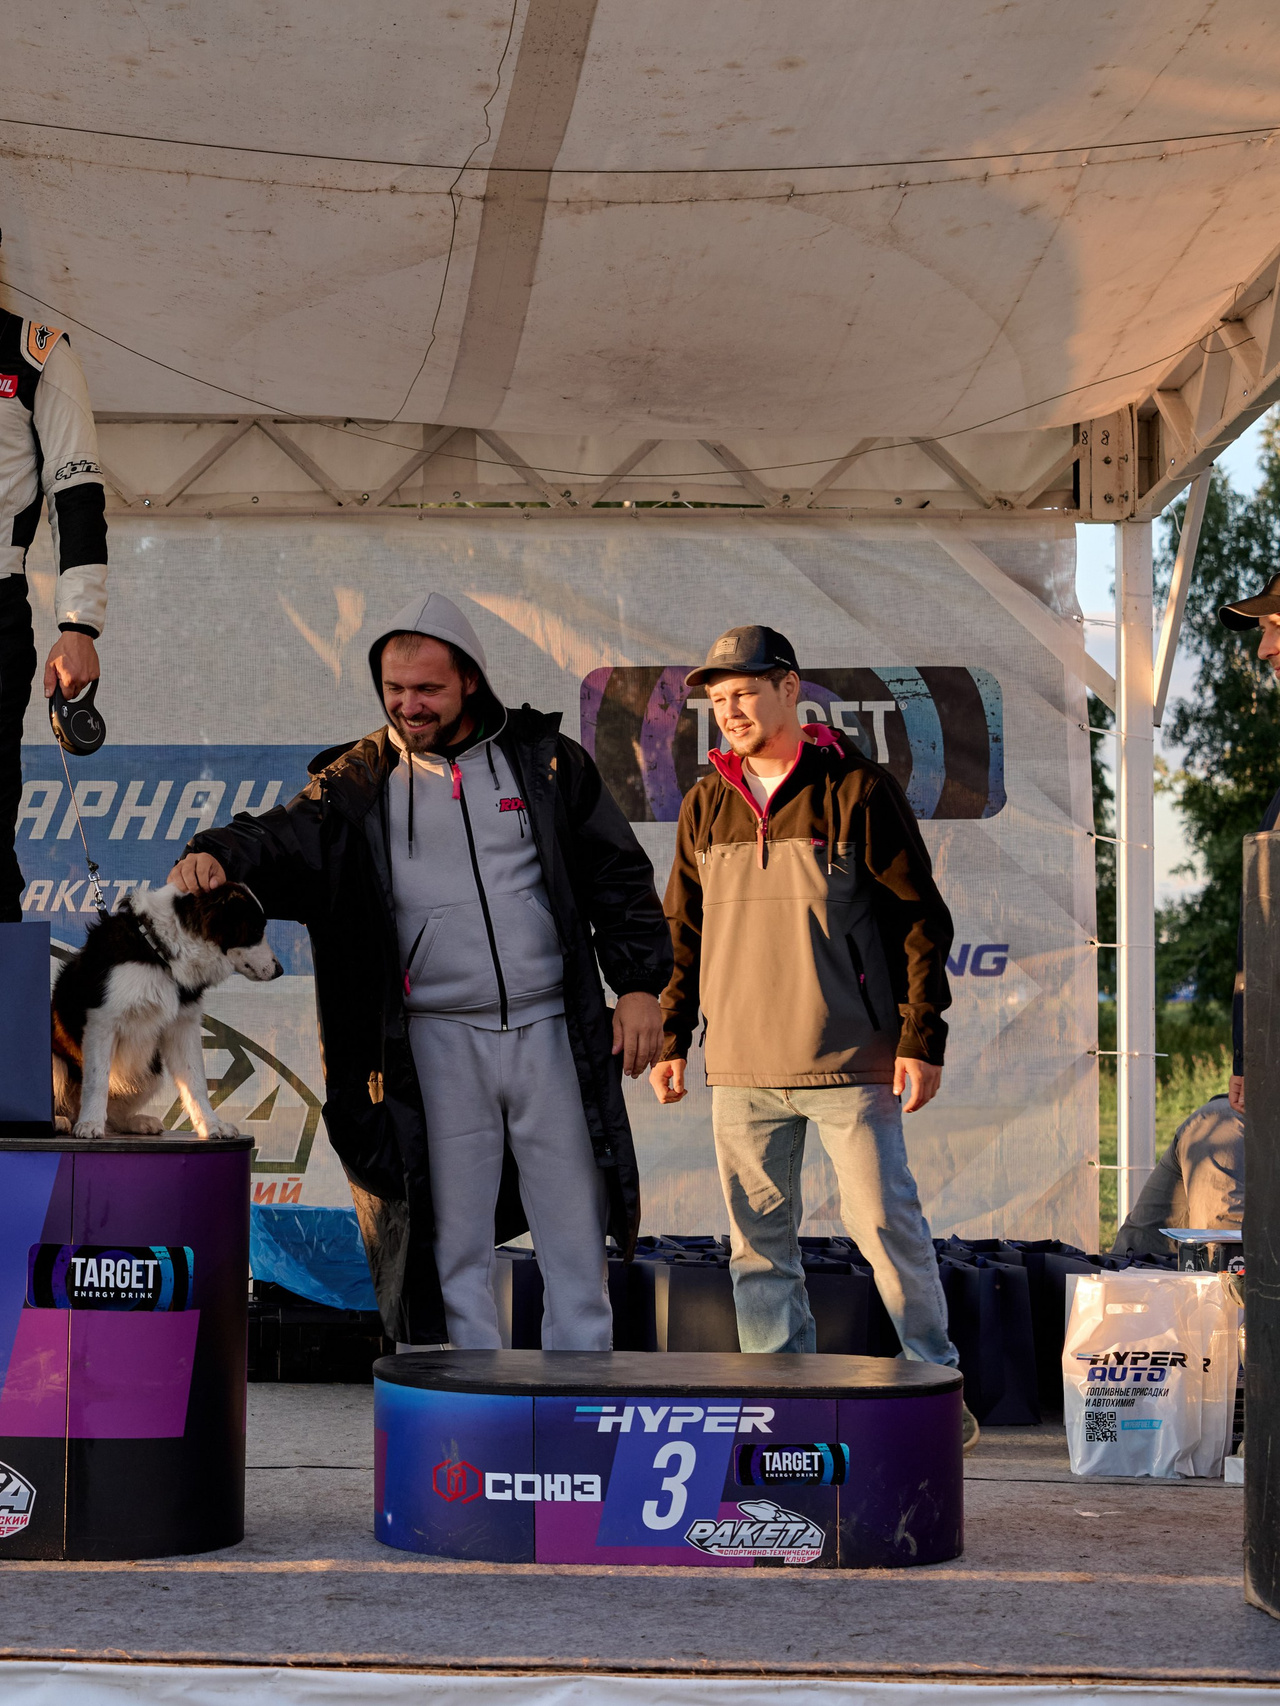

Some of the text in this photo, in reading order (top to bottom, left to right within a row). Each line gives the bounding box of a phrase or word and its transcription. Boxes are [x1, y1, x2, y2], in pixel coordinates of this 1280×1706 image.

[15, 780, 283, 840] АРНАУ
[71, 1257, 158, 1289] TARGET
[74, 1290, 115, 1298] ENERGY
[1089, 1351, 1188, 1368] HYPER
[1087, 1367, 1167, 1382] AUTO
[1085, 1399, 1135, 1407] И АВТОХИМИЯ
[1086, 1387, 1169, 1397] ТОПЛИВНЫЕ ПРИСАДКИ
[597, 1406, 775, 1434] HYPER
[762, 1452, 821, 1471] TARGET
[484, 1472, 601, 1502] СОЮЗ
[641, 1440, 697, 1531] 3
[687, 1522, 822, 1547] РАКЕТА
